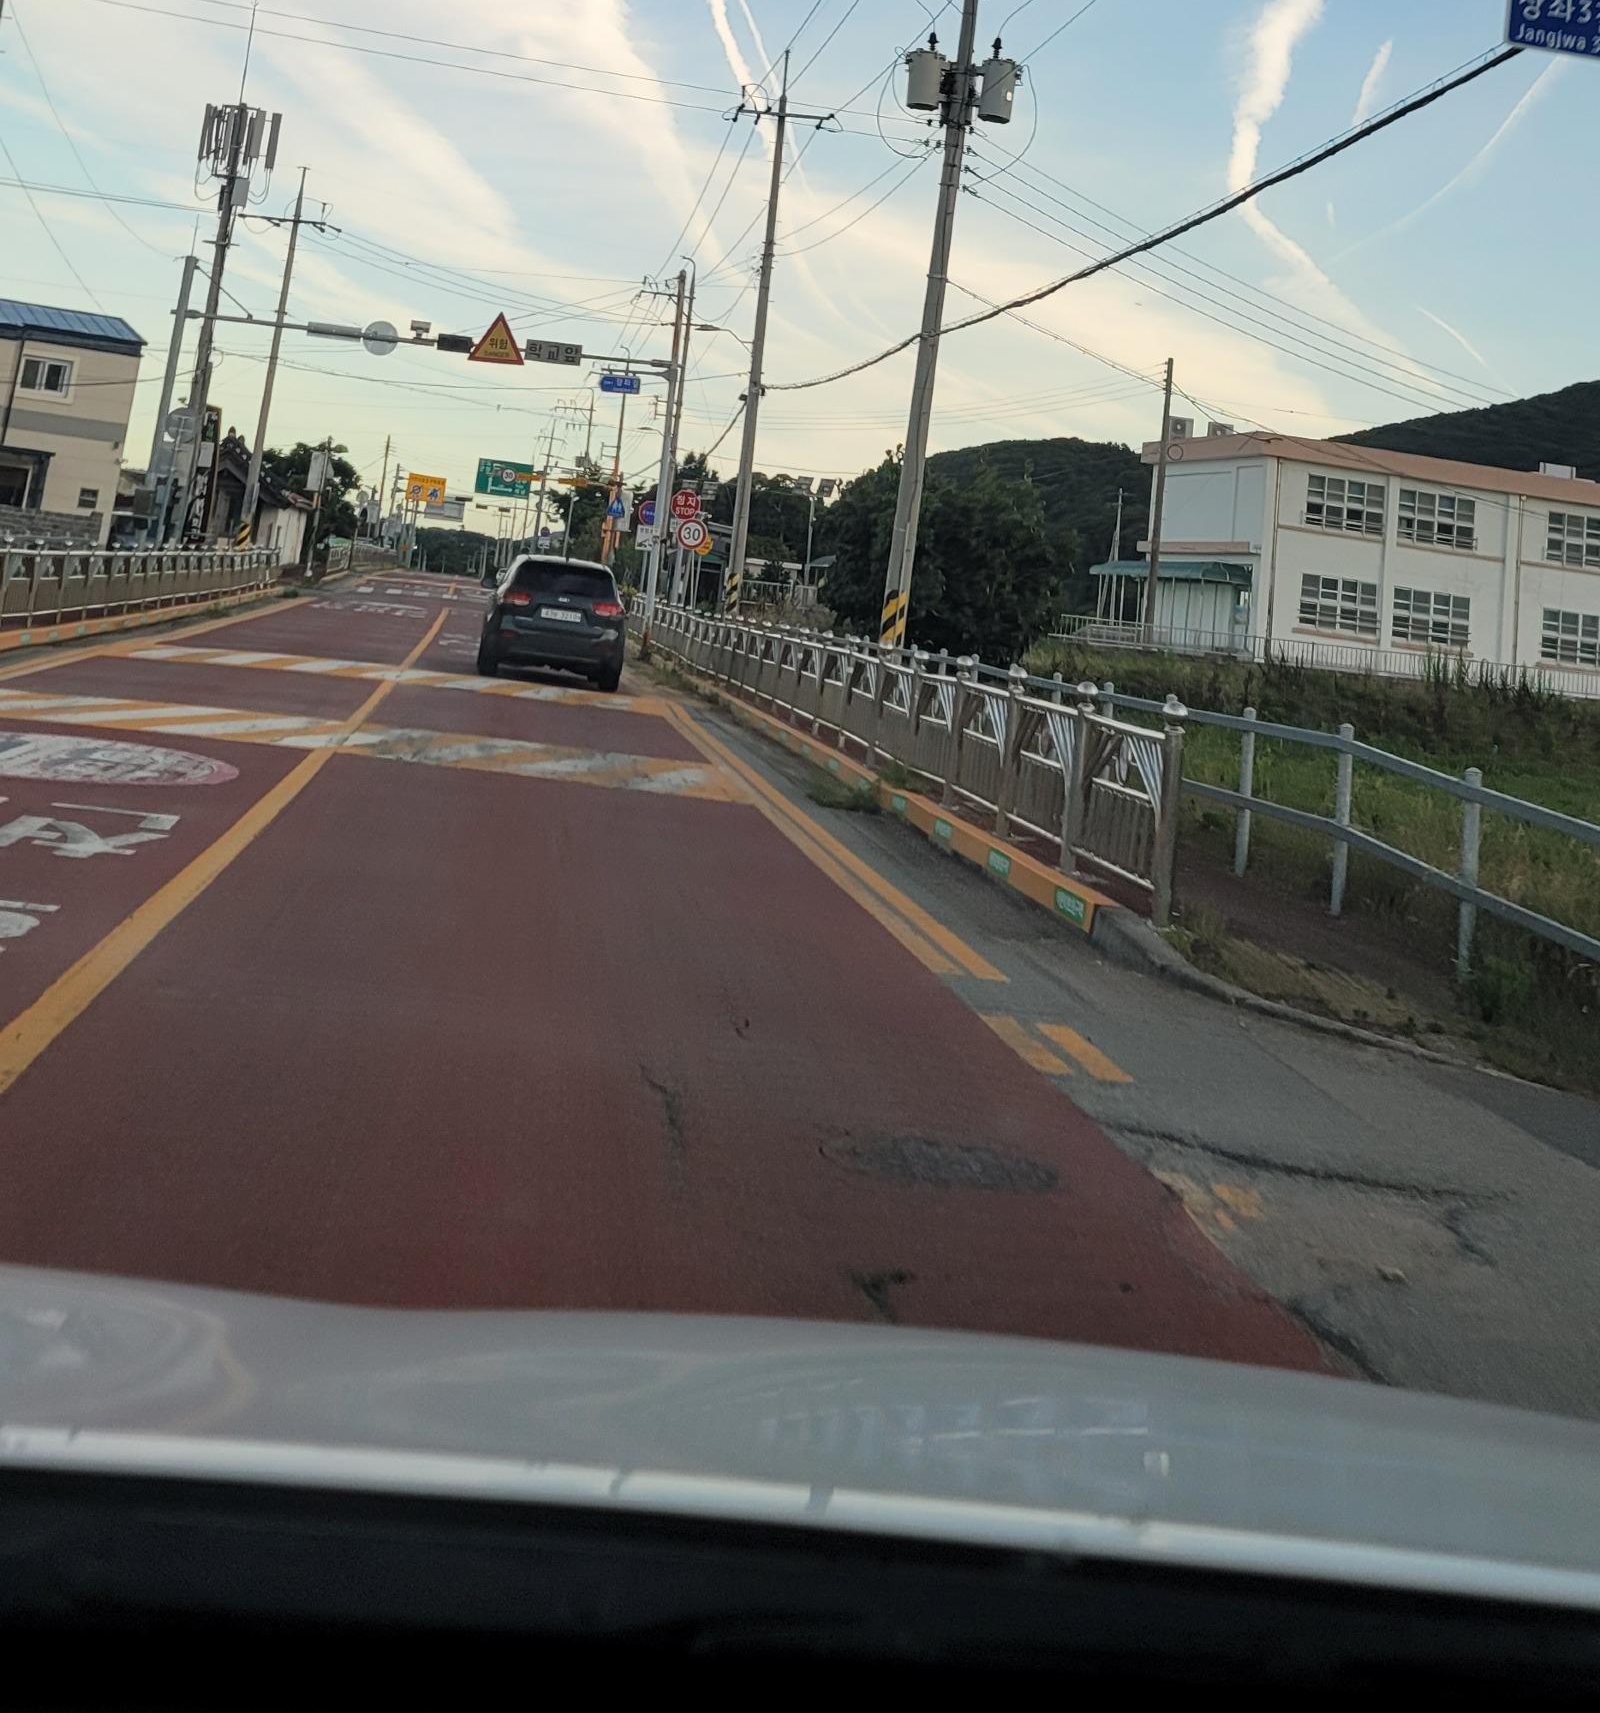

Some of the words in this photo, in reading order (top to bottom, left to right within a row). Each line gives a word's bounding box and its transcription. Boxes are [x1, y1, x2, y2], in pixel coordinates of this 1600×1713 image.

[1515, 23, 1587, 51] Jangjwa
[488, 337, 508, 350] 위험
[676, 495, 696, 507] 정지
[675, 506, 695, 516] STOP
[683, 526, 700, 541] 30
